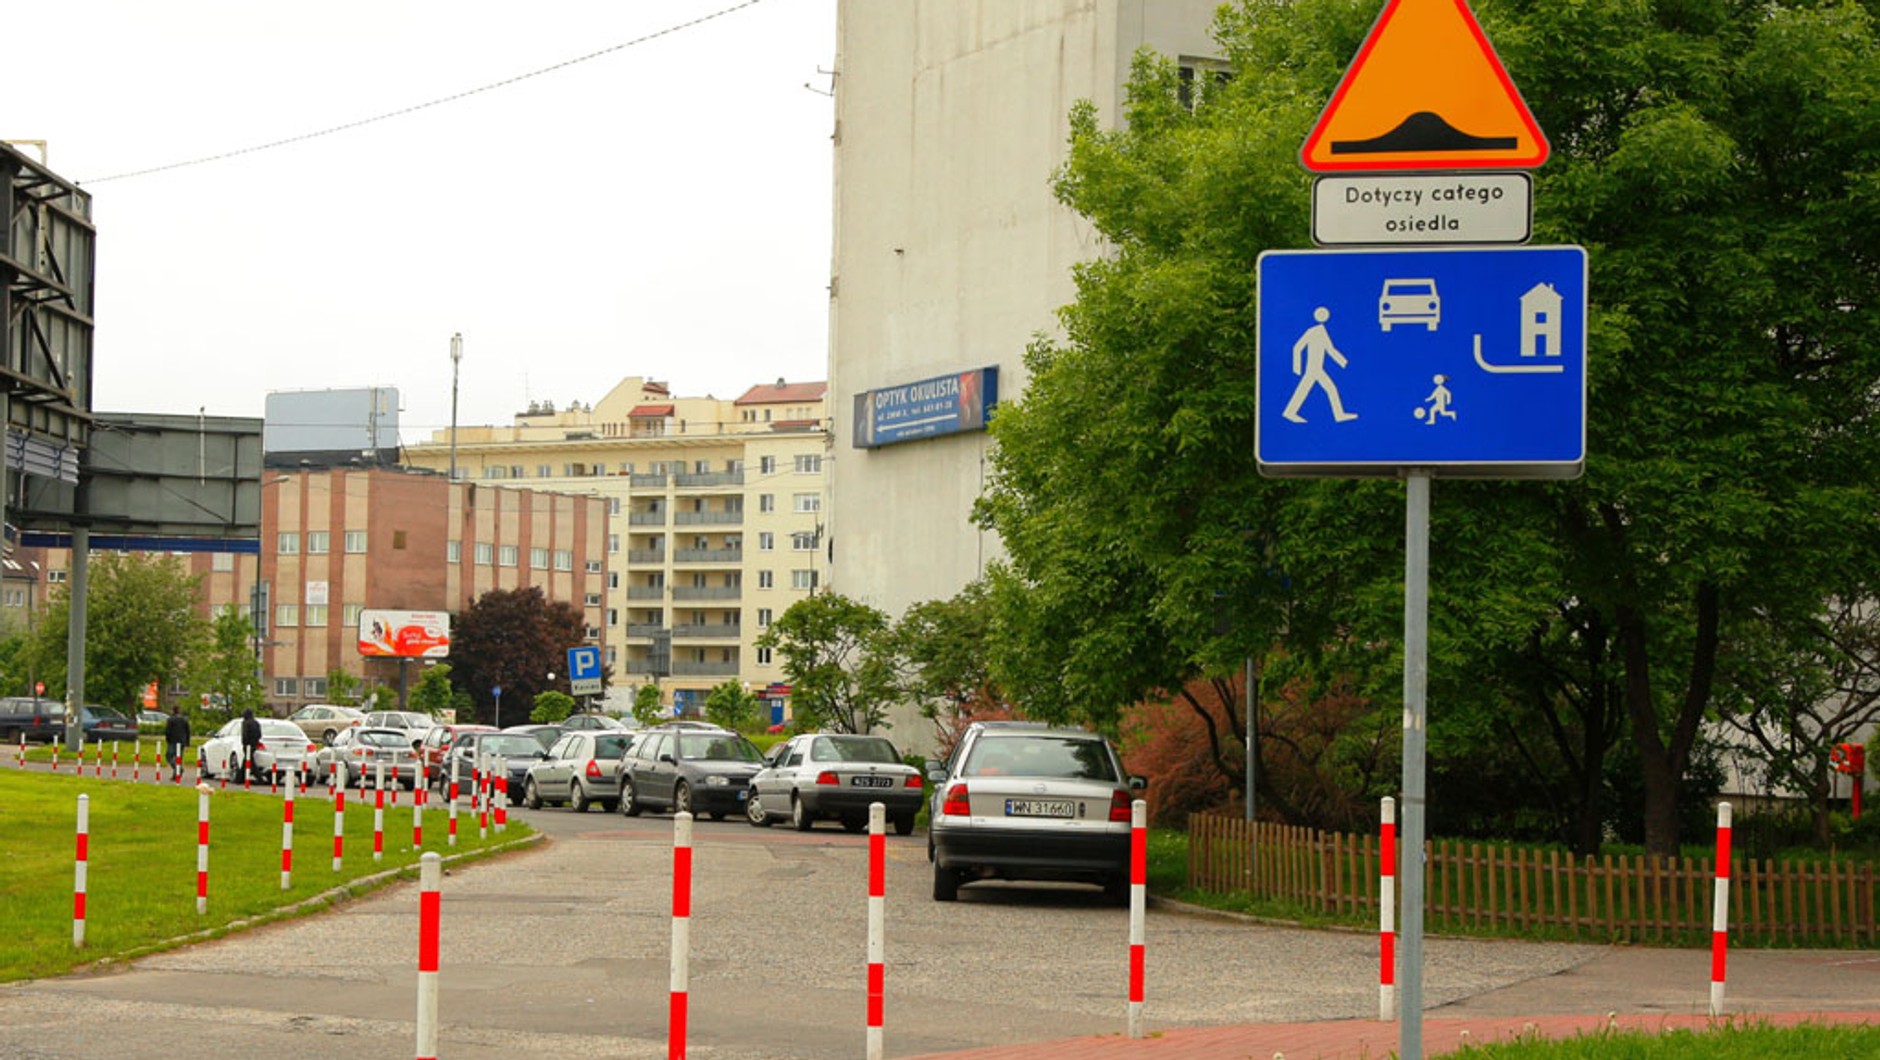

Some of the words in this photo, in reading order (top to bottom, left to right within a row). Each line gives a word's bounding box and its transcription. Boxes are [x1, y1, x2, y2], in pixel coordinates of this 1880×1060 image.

[1345, 186, 1423, 206] Dotyczy
[1431, 184, 1504, 205] całego
[1385, 214, 1460, 232] osiedla
[875, 388, 907, 409] OPTYK
[910, 376, 960, 402] OKULISTA
[575, 651, 595, 676] P
[1013, 801, 1032, 814] WN
[1035, 802, 1072, 817] 31660
